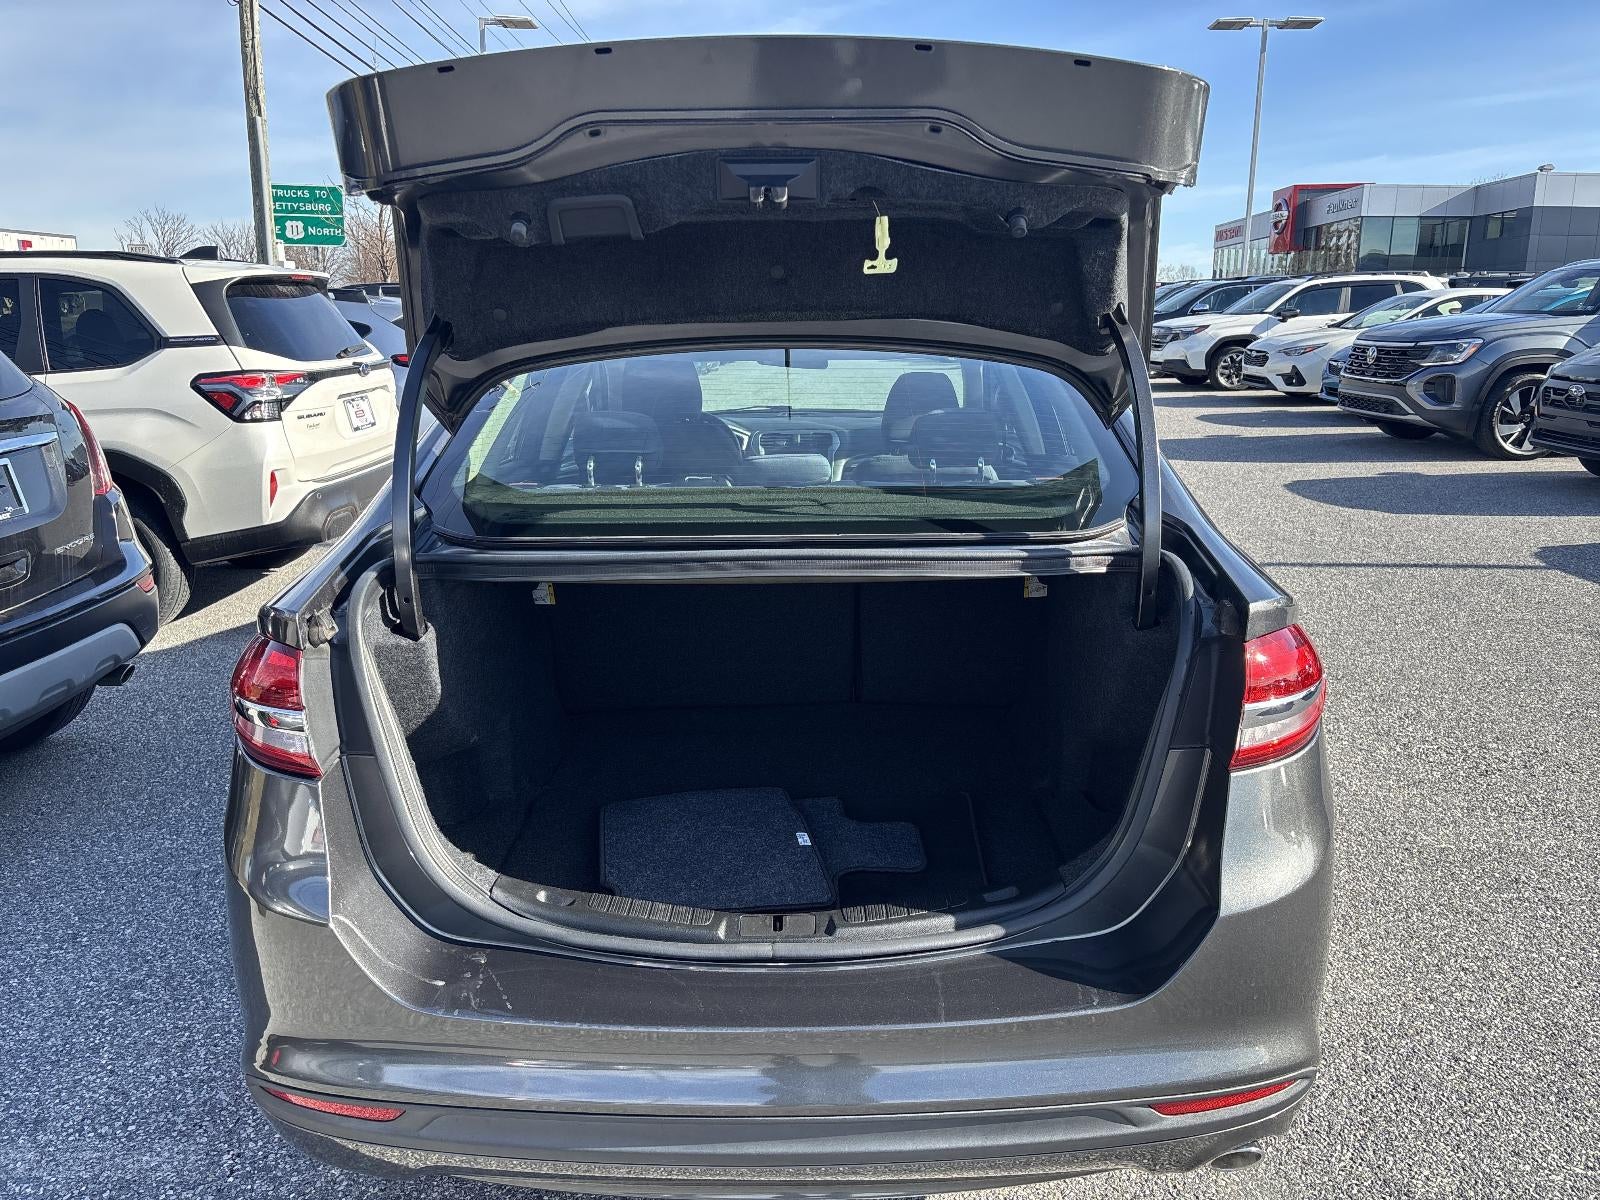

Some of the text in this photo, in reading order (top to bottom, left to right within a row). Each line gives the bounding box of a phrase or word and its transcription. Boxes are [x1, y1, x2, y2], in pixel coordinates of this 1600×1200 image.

[272, 189, 327, 199] TRUCKS TO
[290, 224, 299, 236] 11
[308, 226, 342, 236] NORTH
[297, 412, 326, 420] SUBARU
